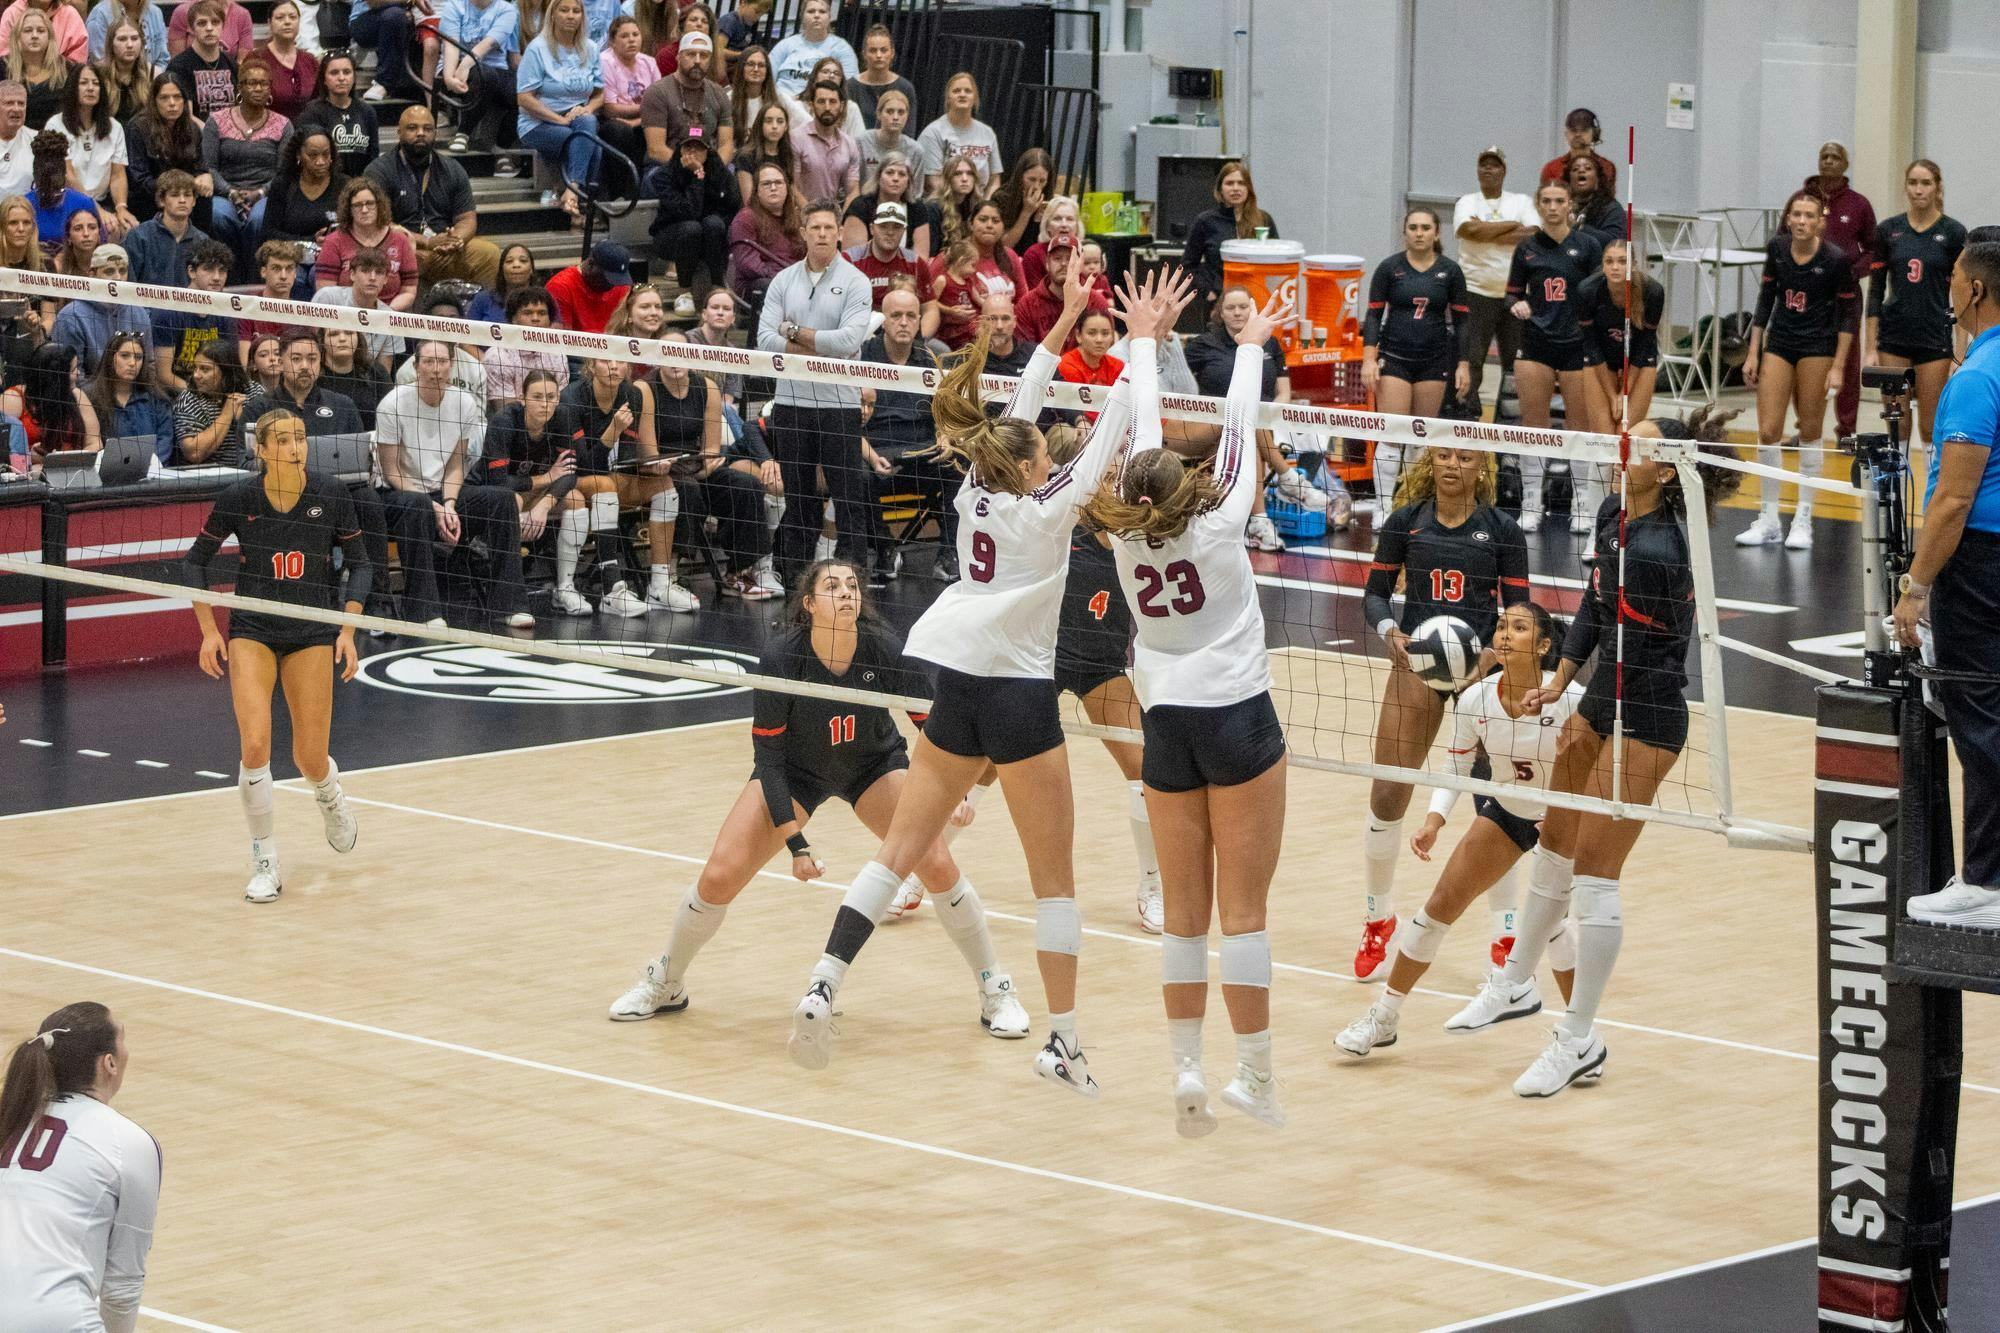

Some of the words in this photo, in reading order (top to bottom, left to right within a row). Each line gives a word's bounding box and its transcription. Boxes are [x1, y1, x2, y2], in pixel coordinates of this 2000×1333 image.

[18, 273, 50, 287] CAROLINA
[51, 277, 90, 291] GAMECOCKS
[1907, 258, 1923, 283] 3
[136, 287, 170, 300] CAROLINA
[172, 292, 213, 305] GAMECOCKS
[1280, 278, 1296, 305] G
[1344, 281, 1359, 304] G
[1544, 277, 1566, 302] 12
[1785, 289, 1806, 312] 14
[259, 302, 294, 315] CAROLINA
[297, 306, 339, 320] GAMECOCKS
[1412, 297, 1429, 320] 7
[389, 315, 425, 330] CAROLINA
[427, 320, 470, 334] GAMECOCKS
[522, 330, 560, 345] CAROLINA
[562, 334, 608, 350] GAMECOCKS
[661, 345, 700, 360] CAROLINA
[703, 349, 750, 365] GAMECOCKS
[1303, 351, 1341, 363] GATORADE
[806, 360, 847, 376] CAROLINA
[849, 364, 899, 381] GAMECOCKS
[1162, 397, 1217, 414] GAMECOCKS
[1282, 409, 1327, 425] CAROLINA
[1330, 413, 1386, 431] GAMECOCKS
[1454, 424, 1500, 442] CAROLINA
[1503, 429, 1563, 448] GAMECOCKS
[272, 551, 305, 580] 10
[969, 530, 996, 583] 9
[1135, 559, 1206, 618] 23
[1430, 569, 1464, 602] 13
[1088, 590, 1110, 620] 4
[829, 715, 855, 746] 11
[1512, 761, 1534, 781] 5
[1830, 820, 1887, 1241] GAMECOCKS
